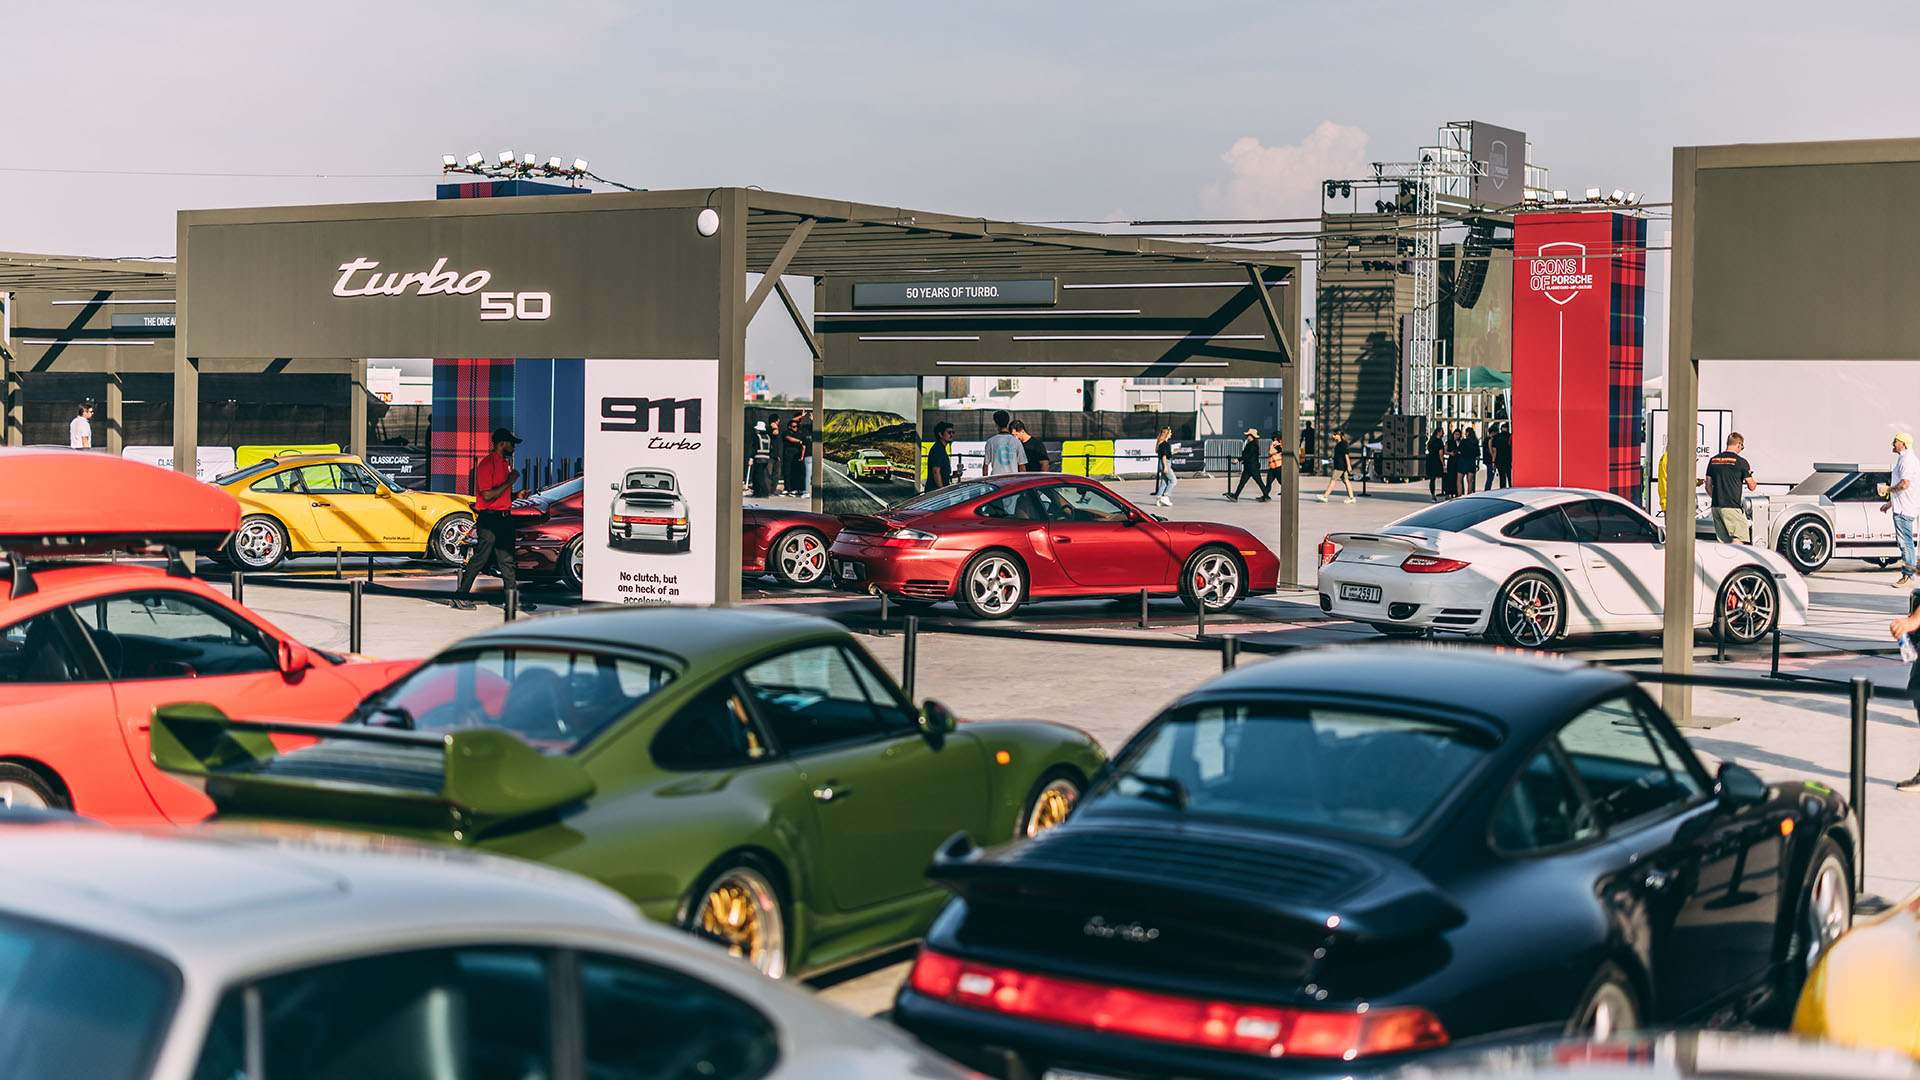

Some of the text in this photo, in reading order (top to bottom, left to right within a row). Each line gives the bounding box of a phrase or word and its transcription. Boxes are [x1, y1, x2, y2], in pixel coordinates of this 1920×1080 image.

[1530, 258, 1577, 275] ICONS
[332, 257, 492, 297] turbo
[1530, 274, 1593, 290] OF PORSCHE
[906, 286, 1000, 298] 50 YEARS OF TURBO.
[480, 291, 552, 320] 50
[144, 317, 156, 326] THE
[156, 317, 170, 326] ONE
[600, 397, 702, 433] 911
[648, 437, 702, 451] turbo
[370, 456, 394, 464] CLASSIC
[400, 465, 413, 473] ART
[619, 571, 678, 584] No clutch, but
[617, 584, 680, 596] one heck of an
